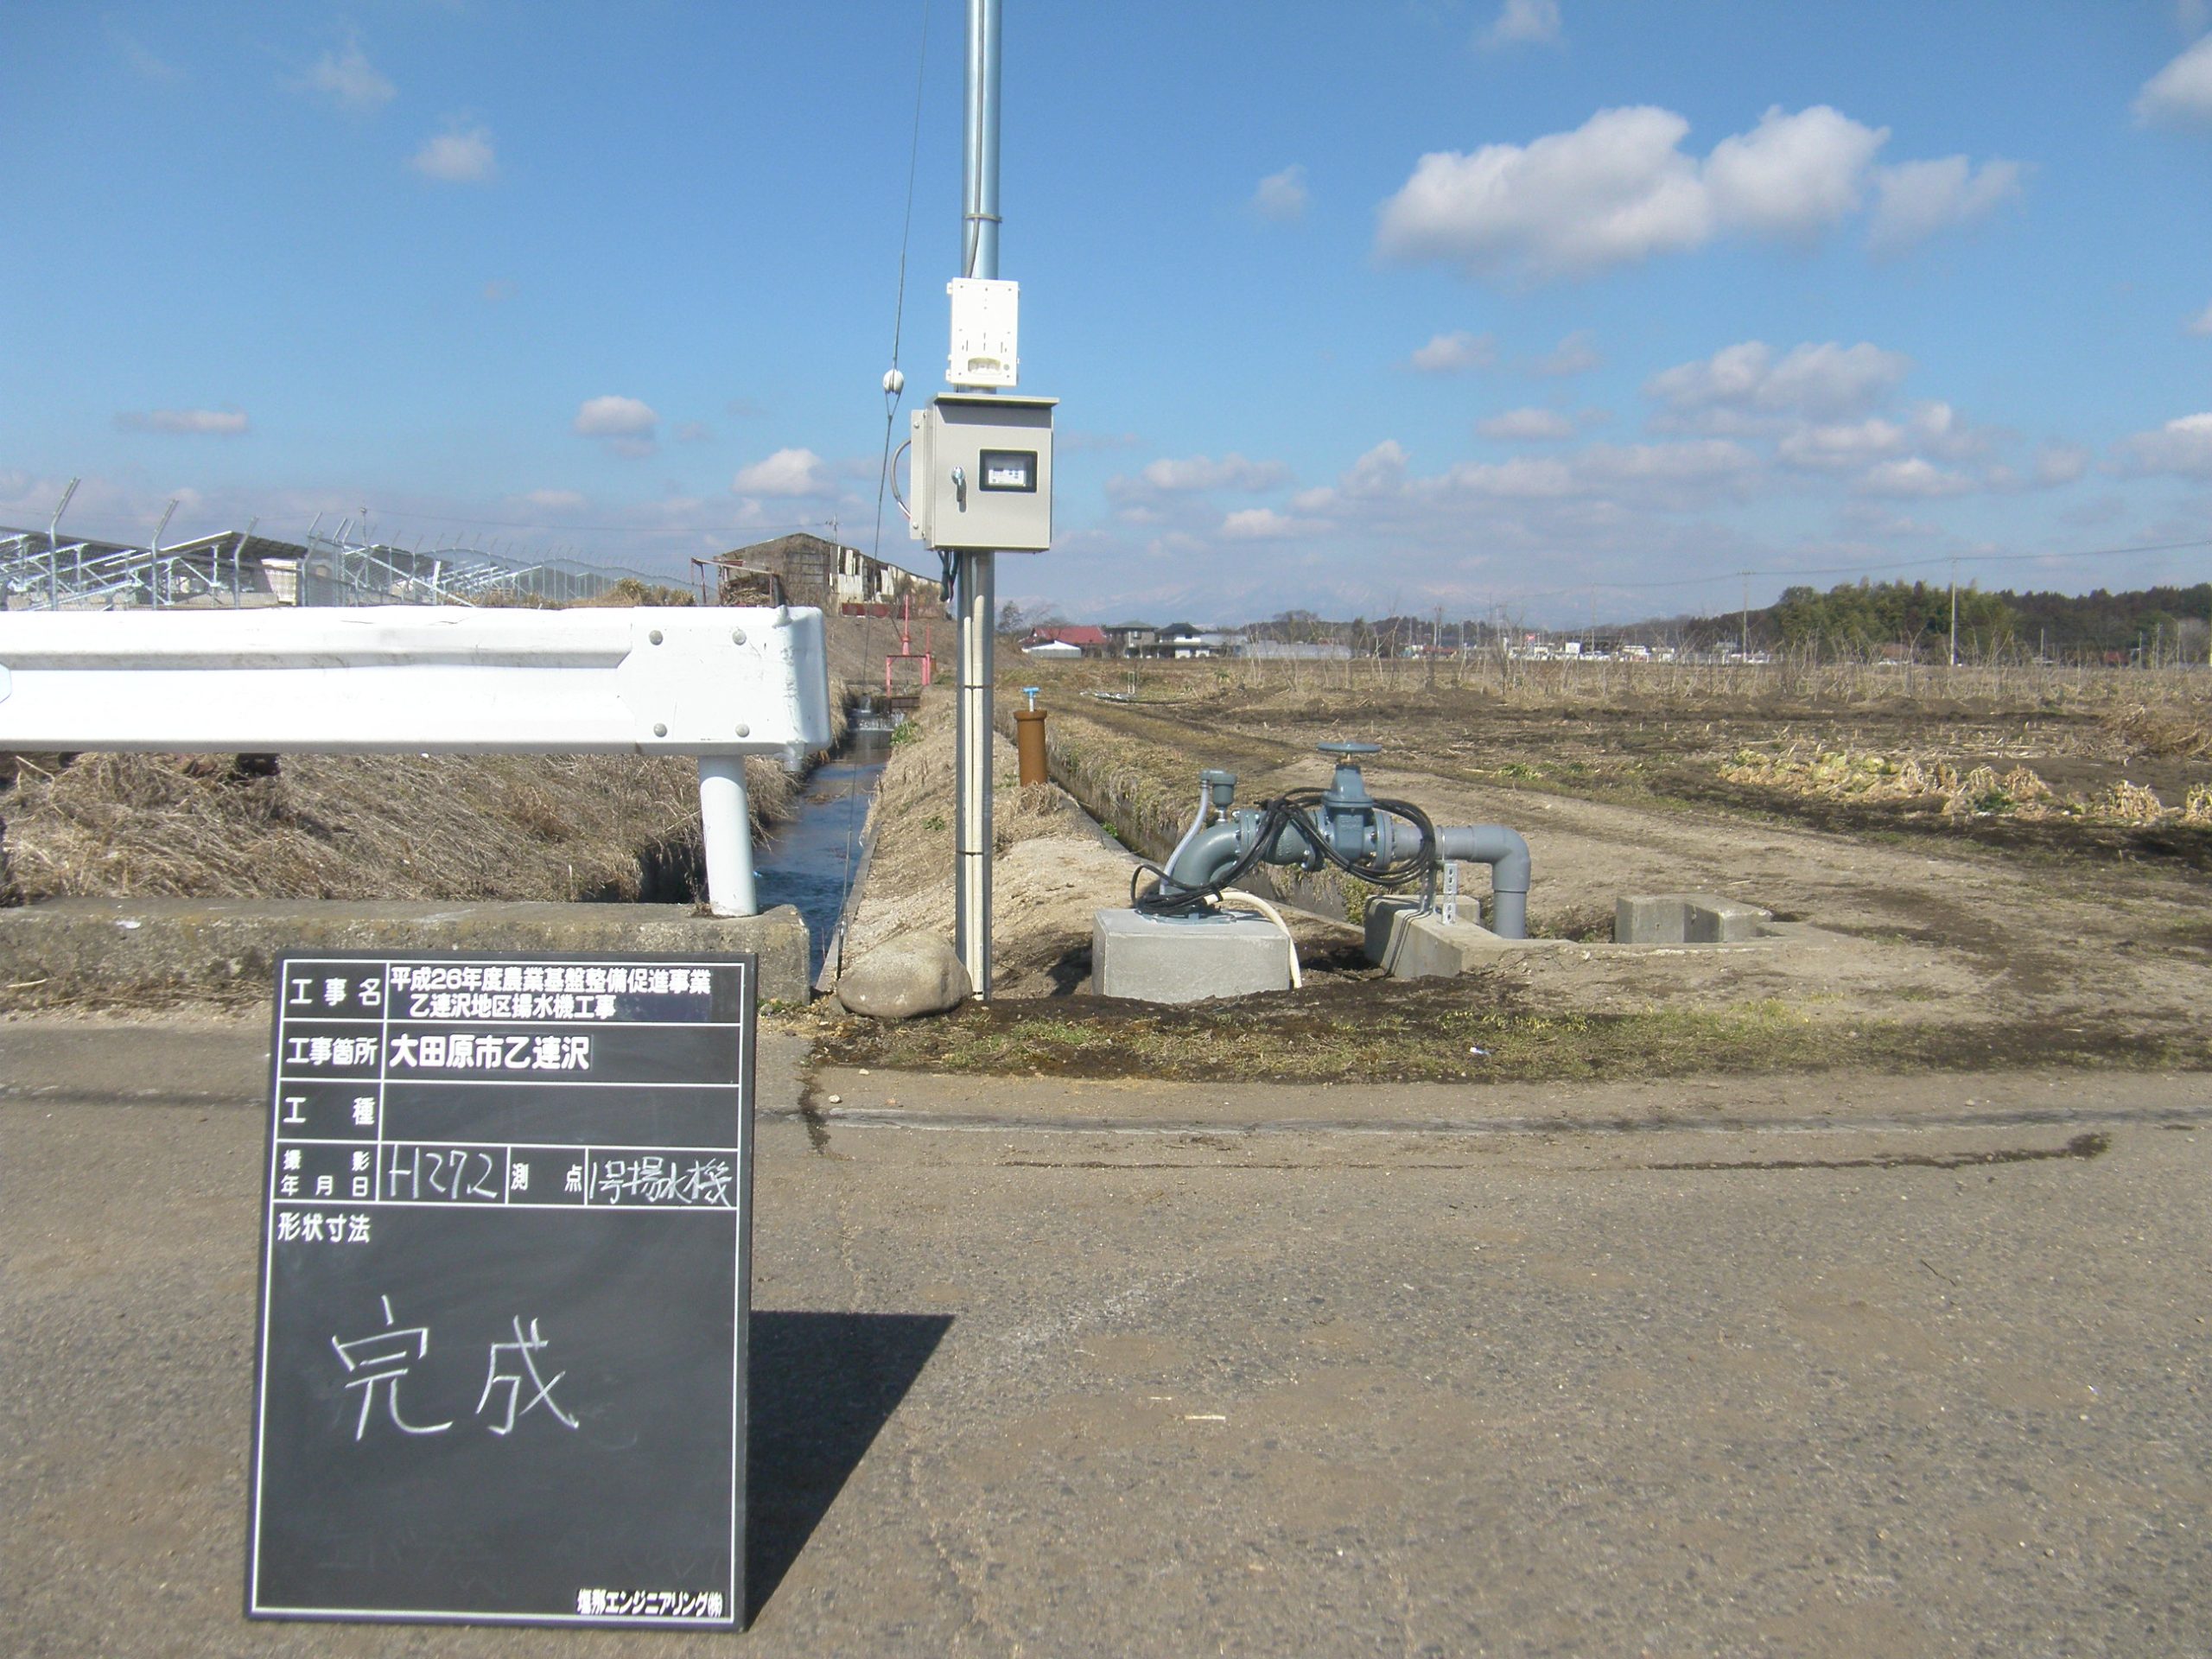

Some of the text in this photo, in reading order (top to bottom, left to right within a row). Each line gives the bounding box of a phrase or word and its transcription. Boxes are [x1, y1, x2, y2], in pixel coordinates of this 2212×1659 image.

[409, 993, 617, 1020] 乙連沢地区揚水機工事
[286, 1036, 379, 1065] 工事箇所
[389, 1033, 590, 1070] 大田原市乙連沢
[277, 1211, 372, 1243] 形状寸法
[331, 1294, 580, 1441] 完成
